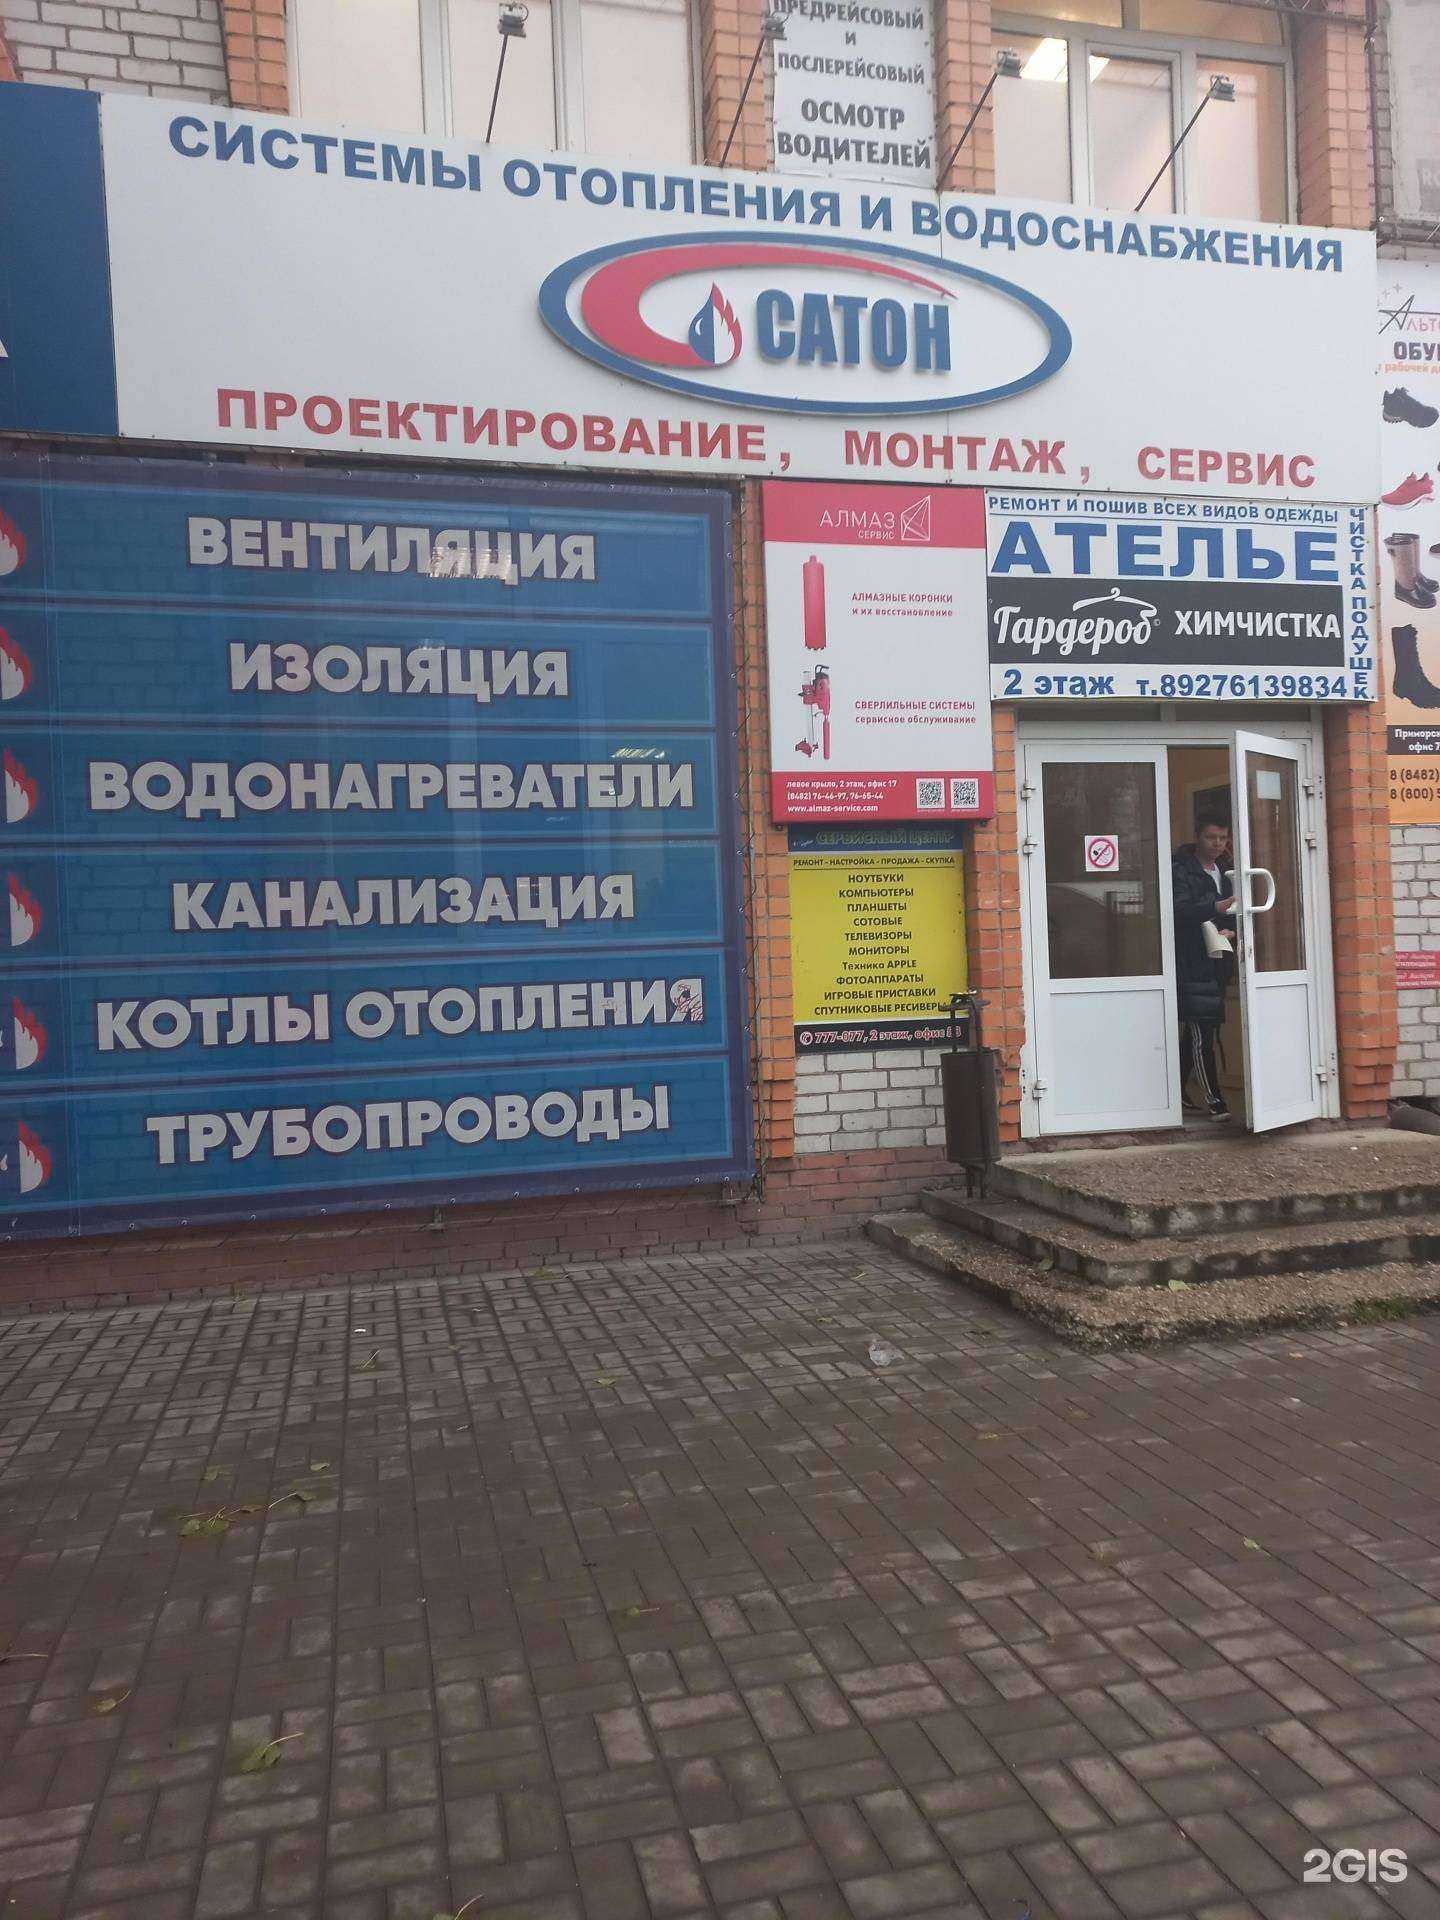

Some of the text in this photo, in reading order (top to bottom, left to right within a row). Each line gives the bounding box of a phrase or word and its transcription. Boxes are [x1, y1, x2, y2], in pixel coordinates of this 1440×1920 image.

[845, 31, 857, 45] И
[778, 53, 925, 85] ПОСЛЕРЕЙСОВЫЙ
[801, 98, 905, 131] ОСМОТР
[777, 132, 931, 169] ВОДИТЕЛЕЙ
[169, 115, 1343, 273] СИСТЕМЫ ОТОПЛЕНИЯ И ВОДОСНАБЖЕНИЯ
[756, 289, 952, 372] САТОН
[217, 388, 1315, 488] ПРОЕКТИРОВАНИЕ, МОНТАЖ, СЕРВИС
[989, 496, 1338, 523] РЕМОНТ И ПОШИВ ВСЕХ ВИДОВ ОДЕЖДЫ
[820, 510, 896, 529] АЛМАЗ
[858, 530, 895, 540] СЕРВИС
[188, 517, 596, 585] ВЕНТИЛЯЦИЯ
[991, 521, 1339, 582] АТЕЛЬЕ
[852, 593, 952, 603] АЛМАЗНЫЕ КОРОНКИ
[1349, 508, 1372, 699] ЧИСТКА ПОДУШЕК
[875, 608, 953, 617] восстановление
[993, 605, 1158, 656] Гардероб
[1175, 610, 1341, 638] ХИМЧИСТКА
[230, 642, 569, 703] ИЗОЛЯЦИЯ
[1004, 669, 1022, 695] 2
[1034, 673, 1114, 696] этаж
[855, 701, 975, 710] СВЕРЛИЛЬНЫЕ СИСТЕМЫ
[855, 715, 976, 724] сервисное обслуживание
[1408, 741, 1434, 753] офис
[1390, 768, 1440, 783] 8 (8482)
[89, 761, 693, 819] ВОДОНАГРЕВАТЕЛИ
[811, 781, 838, 789] крыло,
[867, 780, 887, 789] офис
[787, 804, 879, 812] www.almaz-service.com
[829, 857, 875, 866] НАСТРОЙКА
[881, 858, 920, 866] ПРОДАЖА
[925, 857, 955, 865] СКУПКА
[848, 874, 904, 883] НОУТБУКИ
[839, 888, 914, 898] КОМПЬЮТЕРЫ
[172, 875, 634, 930] КАНАЛИЗАЦИЯ
[847, 903, 907, 912] ПЛАНШЕТЫ
[853, 917, 903, 926] СОТОВЫЕ
[845, 931, 912, 941] ТЕЛЕВИЗОРЫ
[849, 946, 910, 956] МОНИТОРЫ
[887, 960, 917, 969] APPLE
[836, 974, 924, 985] ФОТОАППАРАТЫ
[824, 988, 936, 1000] ИГРОВЫЕ ПРИСТАВКИ
[97, 978, 704, 1050] КОТЛЫ ОТОПЛЕНИЯ
[814, 1003, 892, 1015] СПУТНИКОВЫЕ
[870, 1030, 878, 1040] 2
[913, 1026, 945, 1040] офис
[147, 1086, 669, 1164] ТРУБОПРОВОДЫ
